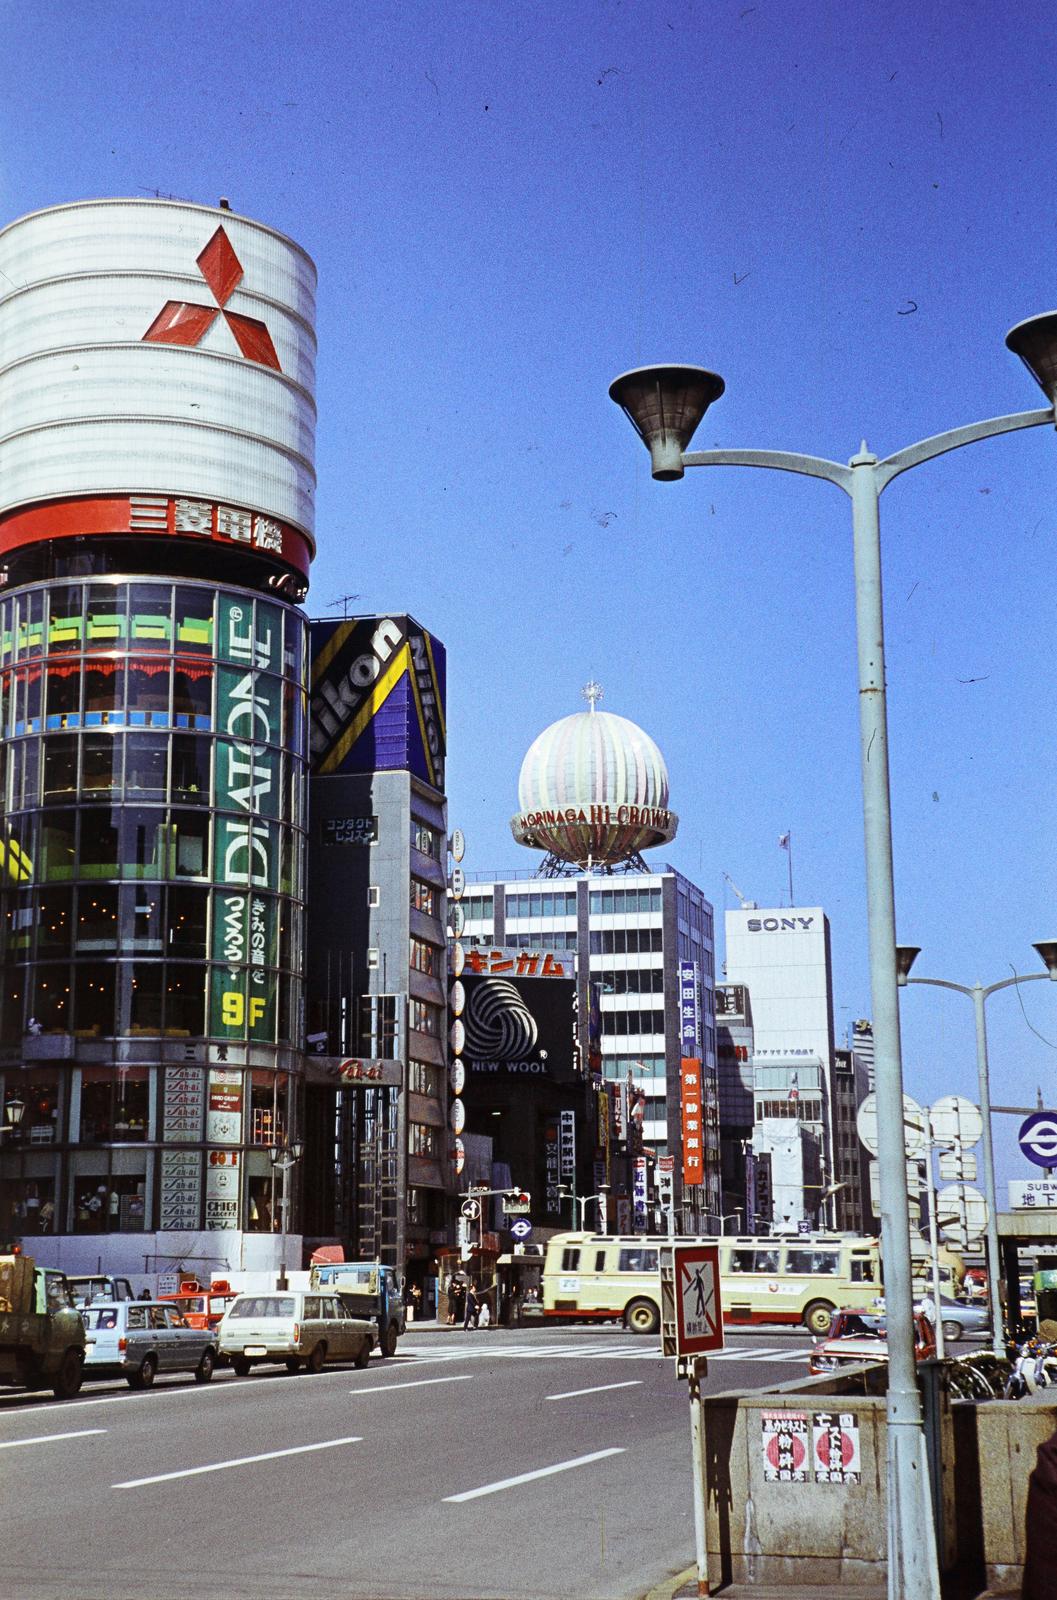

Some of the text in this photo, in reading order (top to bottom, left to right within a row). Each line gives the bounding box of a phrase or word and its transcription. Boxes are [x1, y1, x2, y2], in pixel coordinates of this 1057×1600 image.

[129, 497, 283, 554] 三菱電機
[327, 819, 373, 831] コンタクト
[520, 808, 588, 830] MORINAGA
[747, 917, 814, 932] SONY
[251, 898, 266, 985] きみの音を
[222, 991, 266, 1027] 9F
[682, 968, 696, 1038] 安田生命
[471, 1061, 548, 1074] NEW WOOL
